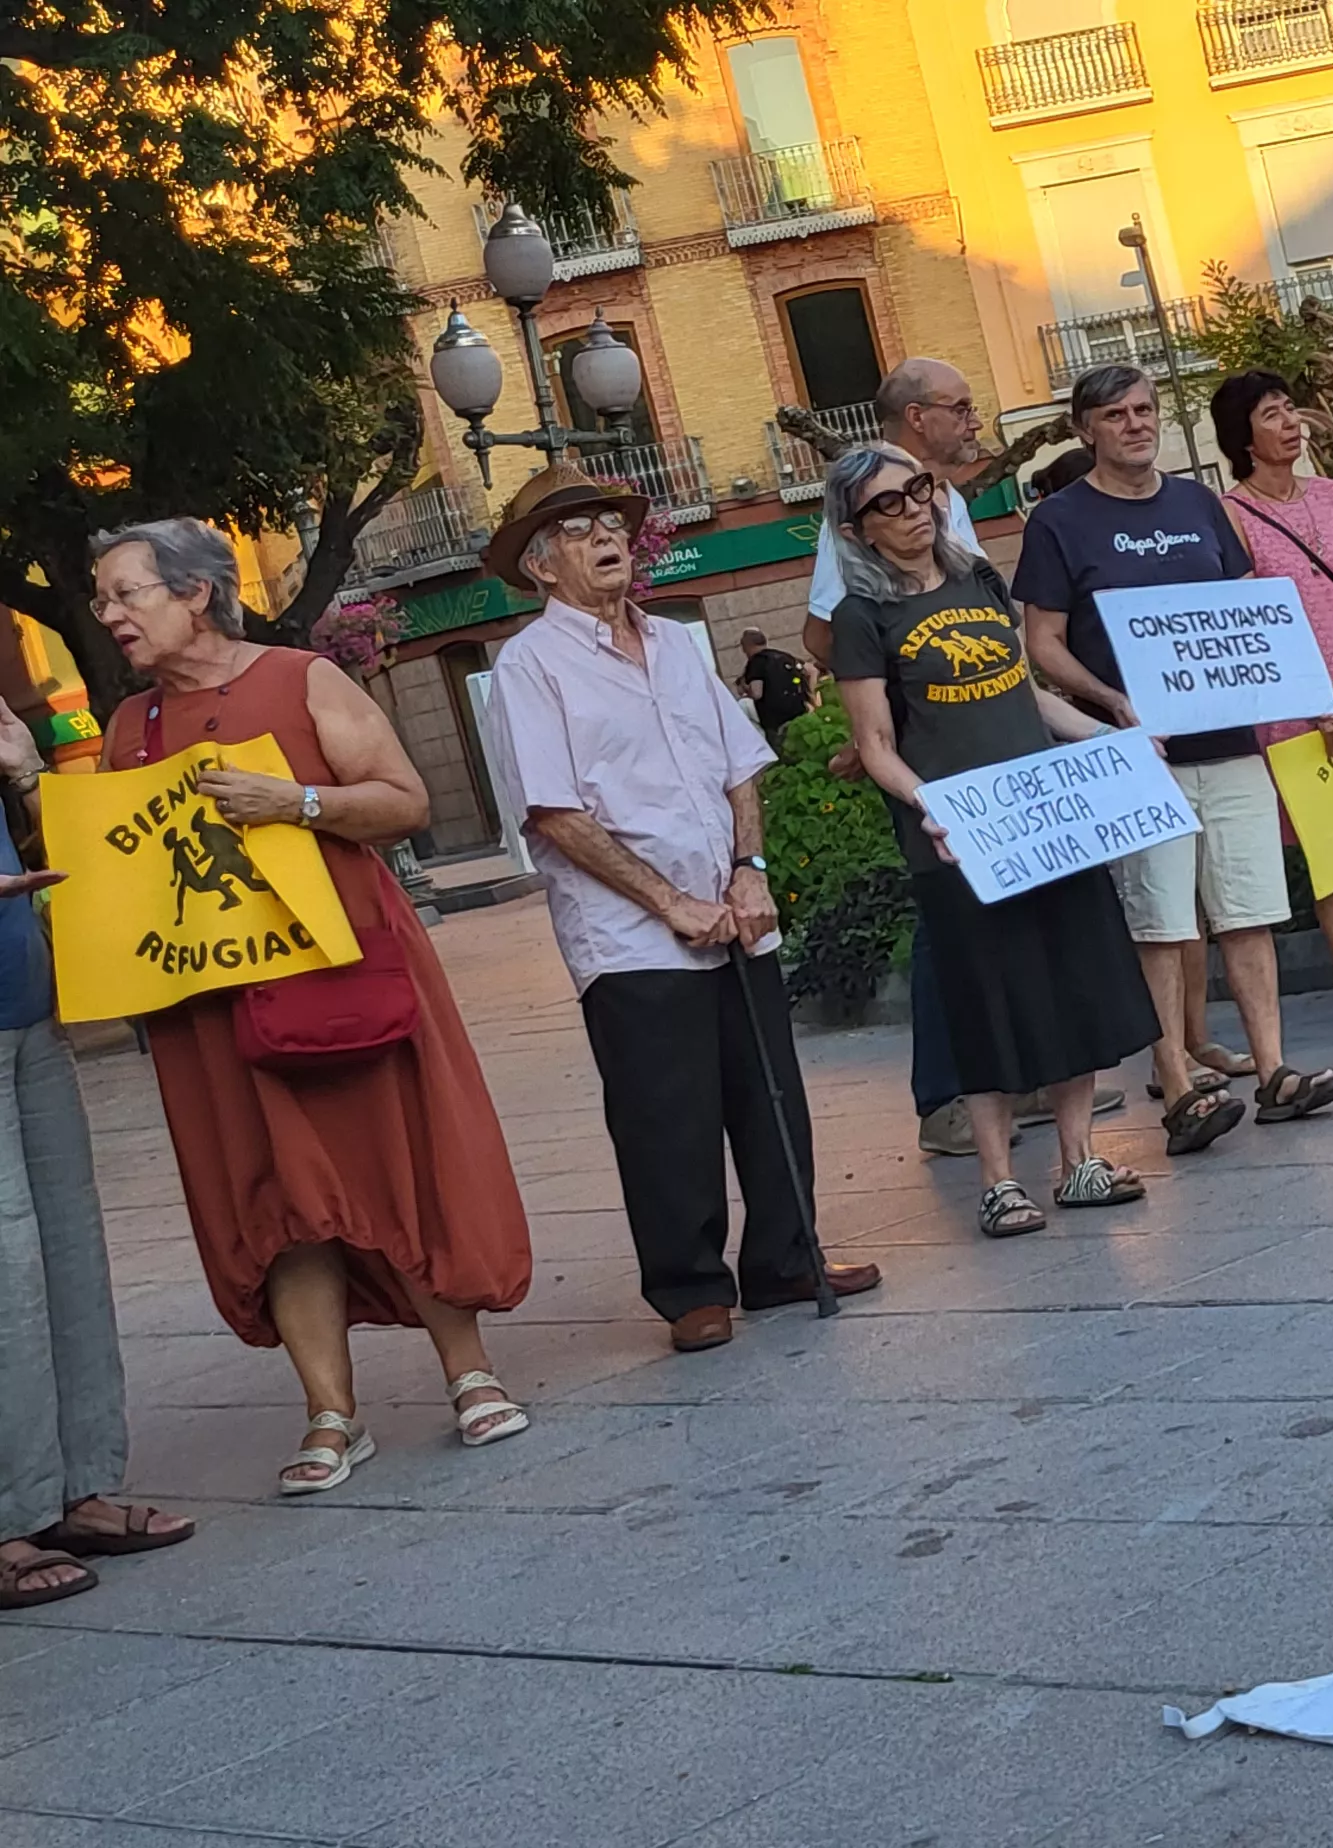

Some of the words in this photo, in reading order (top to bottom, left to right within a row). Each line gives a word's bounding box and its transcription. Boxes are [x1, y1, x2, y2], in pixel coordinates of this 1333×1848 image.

[1113, 532, 1156, 556] Pepe
[1154, 530, 1201, 555] Jeans
[1128, 603, 1294, 639] CONSTRUYAMOS
[1172, 632, 1271, 662] PUENTES
[1161, 669, 1195, 693] NO
[1203, 661, 1282, 690] MUROS
[943, 785, 988, 823] NO
[993, 765, 1053, 808] CABE
[1048, 745, 1133, 788] TANTA
[968, 793, 1096, 856] INJUSTICIA
[990, 852, 1032, 890] EN
[1032, 833, 1091, 873] UNA
[1094, 801, 1188, 853] PATERA
